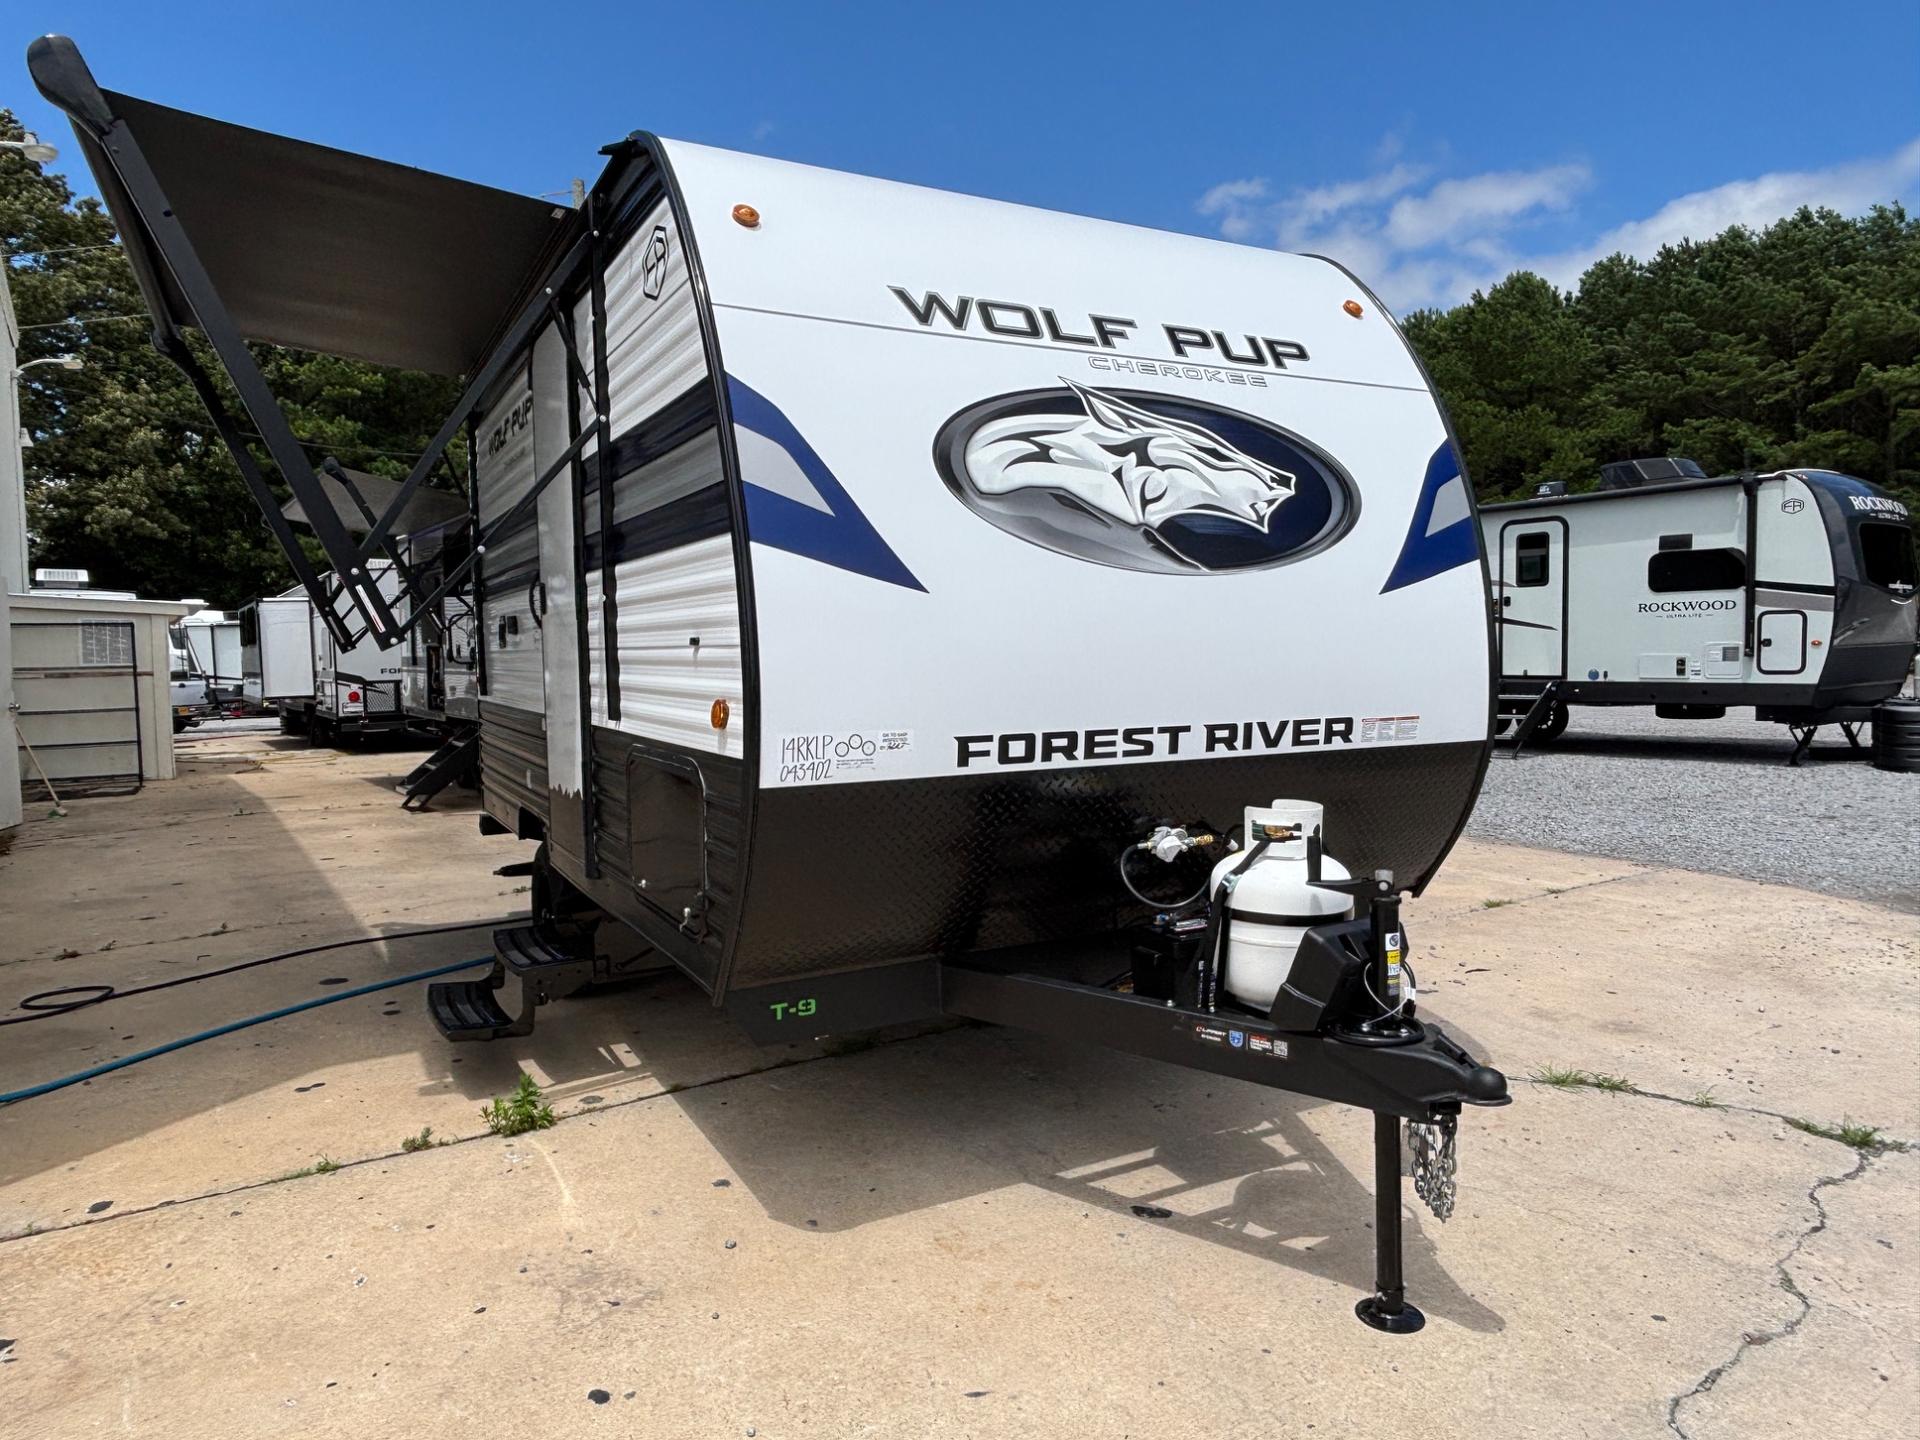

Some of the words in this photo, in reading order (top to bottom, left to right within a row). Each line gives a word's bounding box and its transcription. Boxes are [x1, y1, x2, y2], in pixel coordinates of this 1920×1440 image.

[886, 285, 1138, 349] WOLF
[1161, 322, 1311, 370] PUP
[1088, 355, 1269, 388] CHEROKEE
[488, 415, 510, 457] WOLF
[511, 396, 533, 437] PUP
[1848, 495, 1909, 516] ROCKWOOD
[1637, 600, 1737, 613] ROCKWOOD
[380, 667, 401, 675] FO
[953, 724, 1191, 768] FOREST
[1202, 717, 1354, 753] RIVER
[769, 998, 817, 1021] T-9
